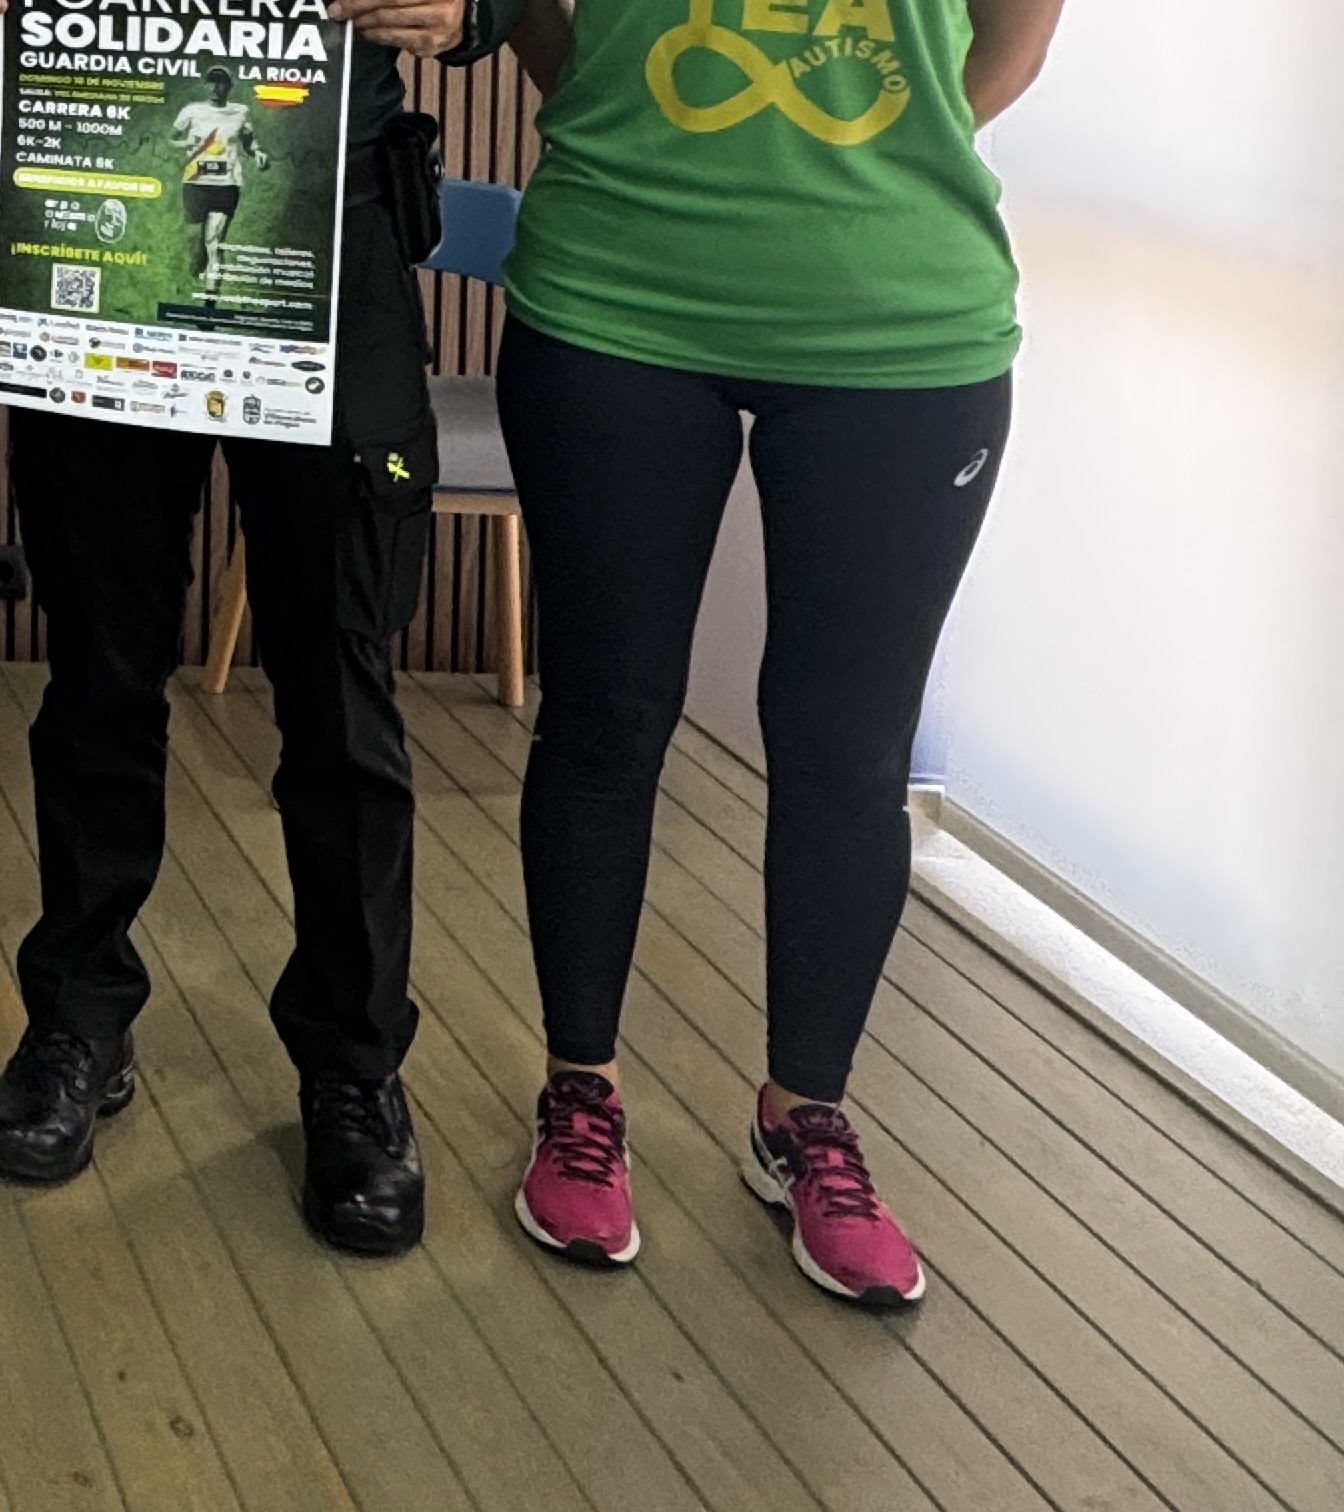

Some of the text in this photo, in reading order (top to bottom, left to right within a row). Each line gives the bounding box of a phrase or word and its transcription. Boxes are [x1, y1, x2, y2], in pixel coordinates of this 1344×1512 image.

[21, 11, 328, 62] SOLIDARIA
[20, 52, 326, 84] GUARDIA CIVIL LA RIOJA
[791, 38, 909, 94] AUTISMO
[19, 100, 102, 117] CARRERA
[19, 117, 45, 130] 500
[16, 151, 91, 168] CAMINATA
